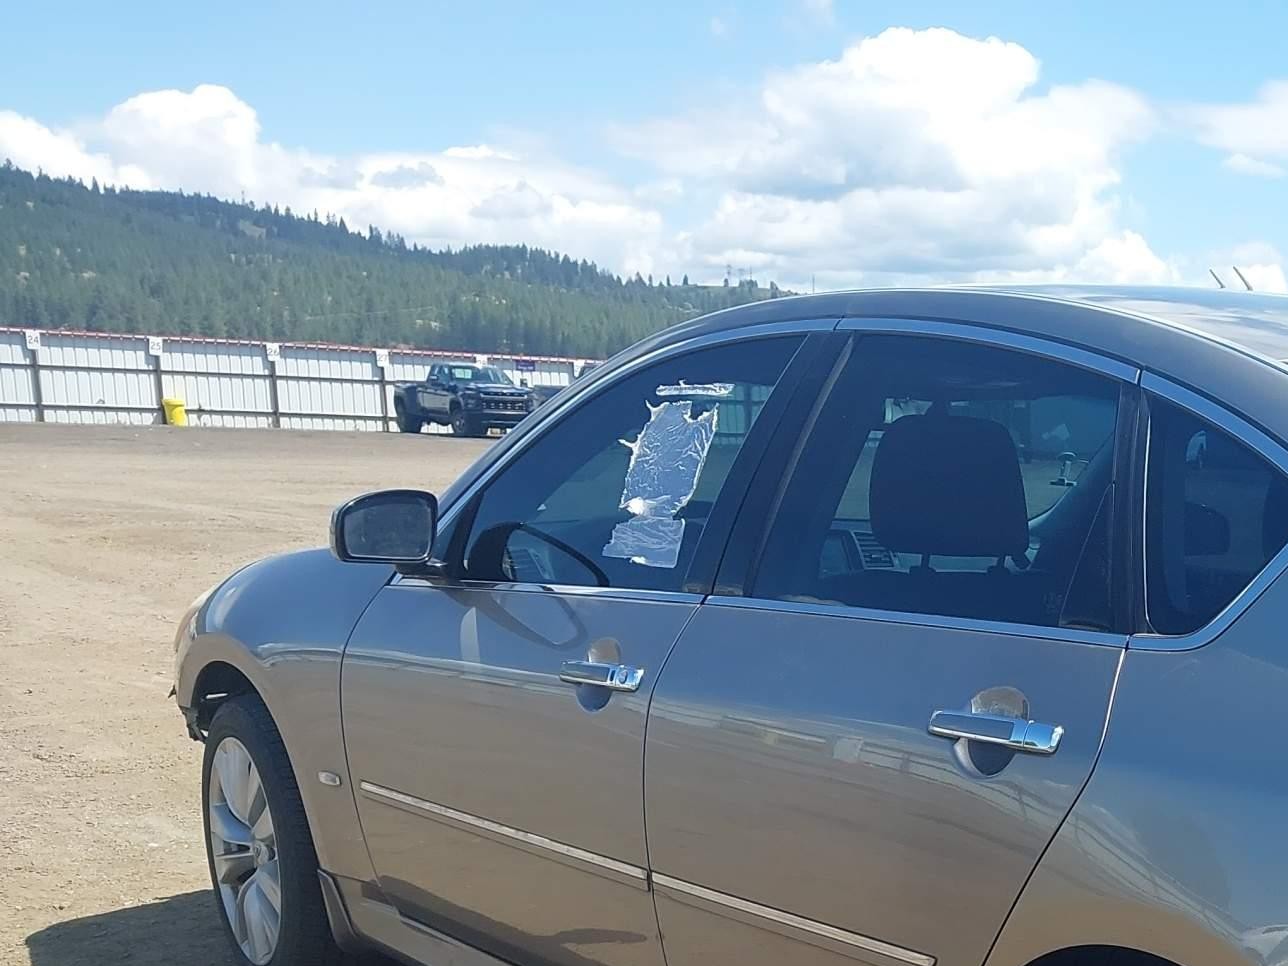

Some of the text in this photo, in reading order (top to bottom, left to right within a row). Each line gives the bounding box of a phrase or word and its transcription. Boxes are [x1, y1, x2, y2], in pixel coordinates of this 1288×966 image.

[28, 334, 39, 345] 24
[150, 341, 161, 351] 25
[267, 347, 279, 356] 26
